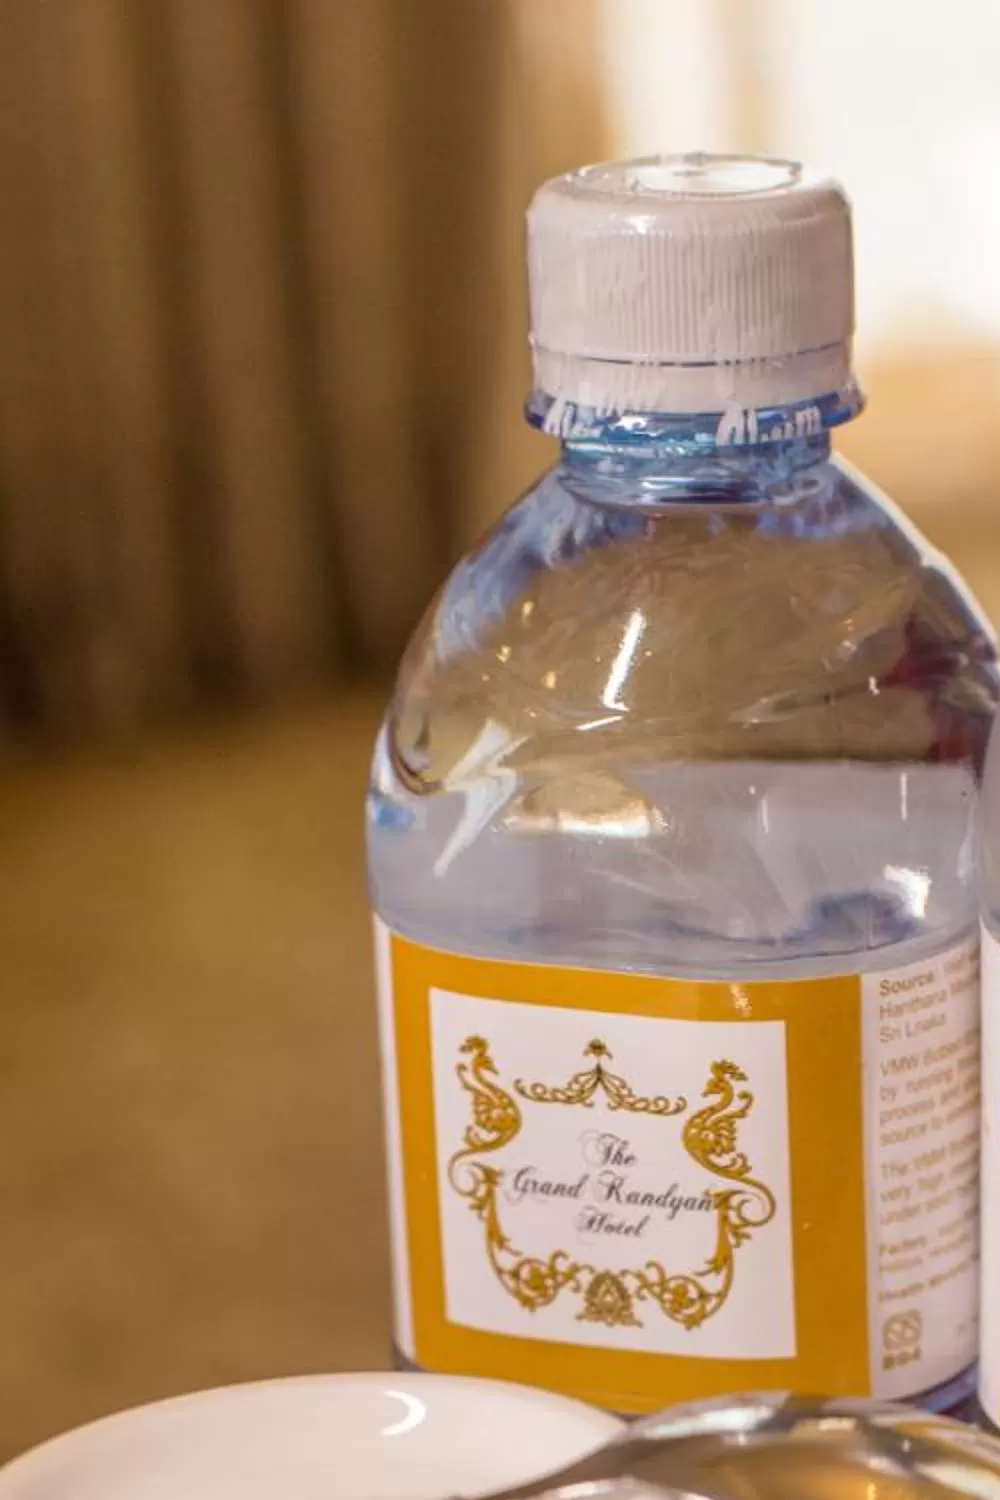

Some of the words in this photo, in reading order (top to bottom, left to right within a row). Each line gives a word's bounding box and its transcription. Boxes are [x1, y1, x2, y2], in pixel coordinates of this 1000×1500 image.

[578, 1128, 637, 1167] The
[505, 1167, 589, 1203] Grand
[574, 1204, 651, 1241] Hotel
